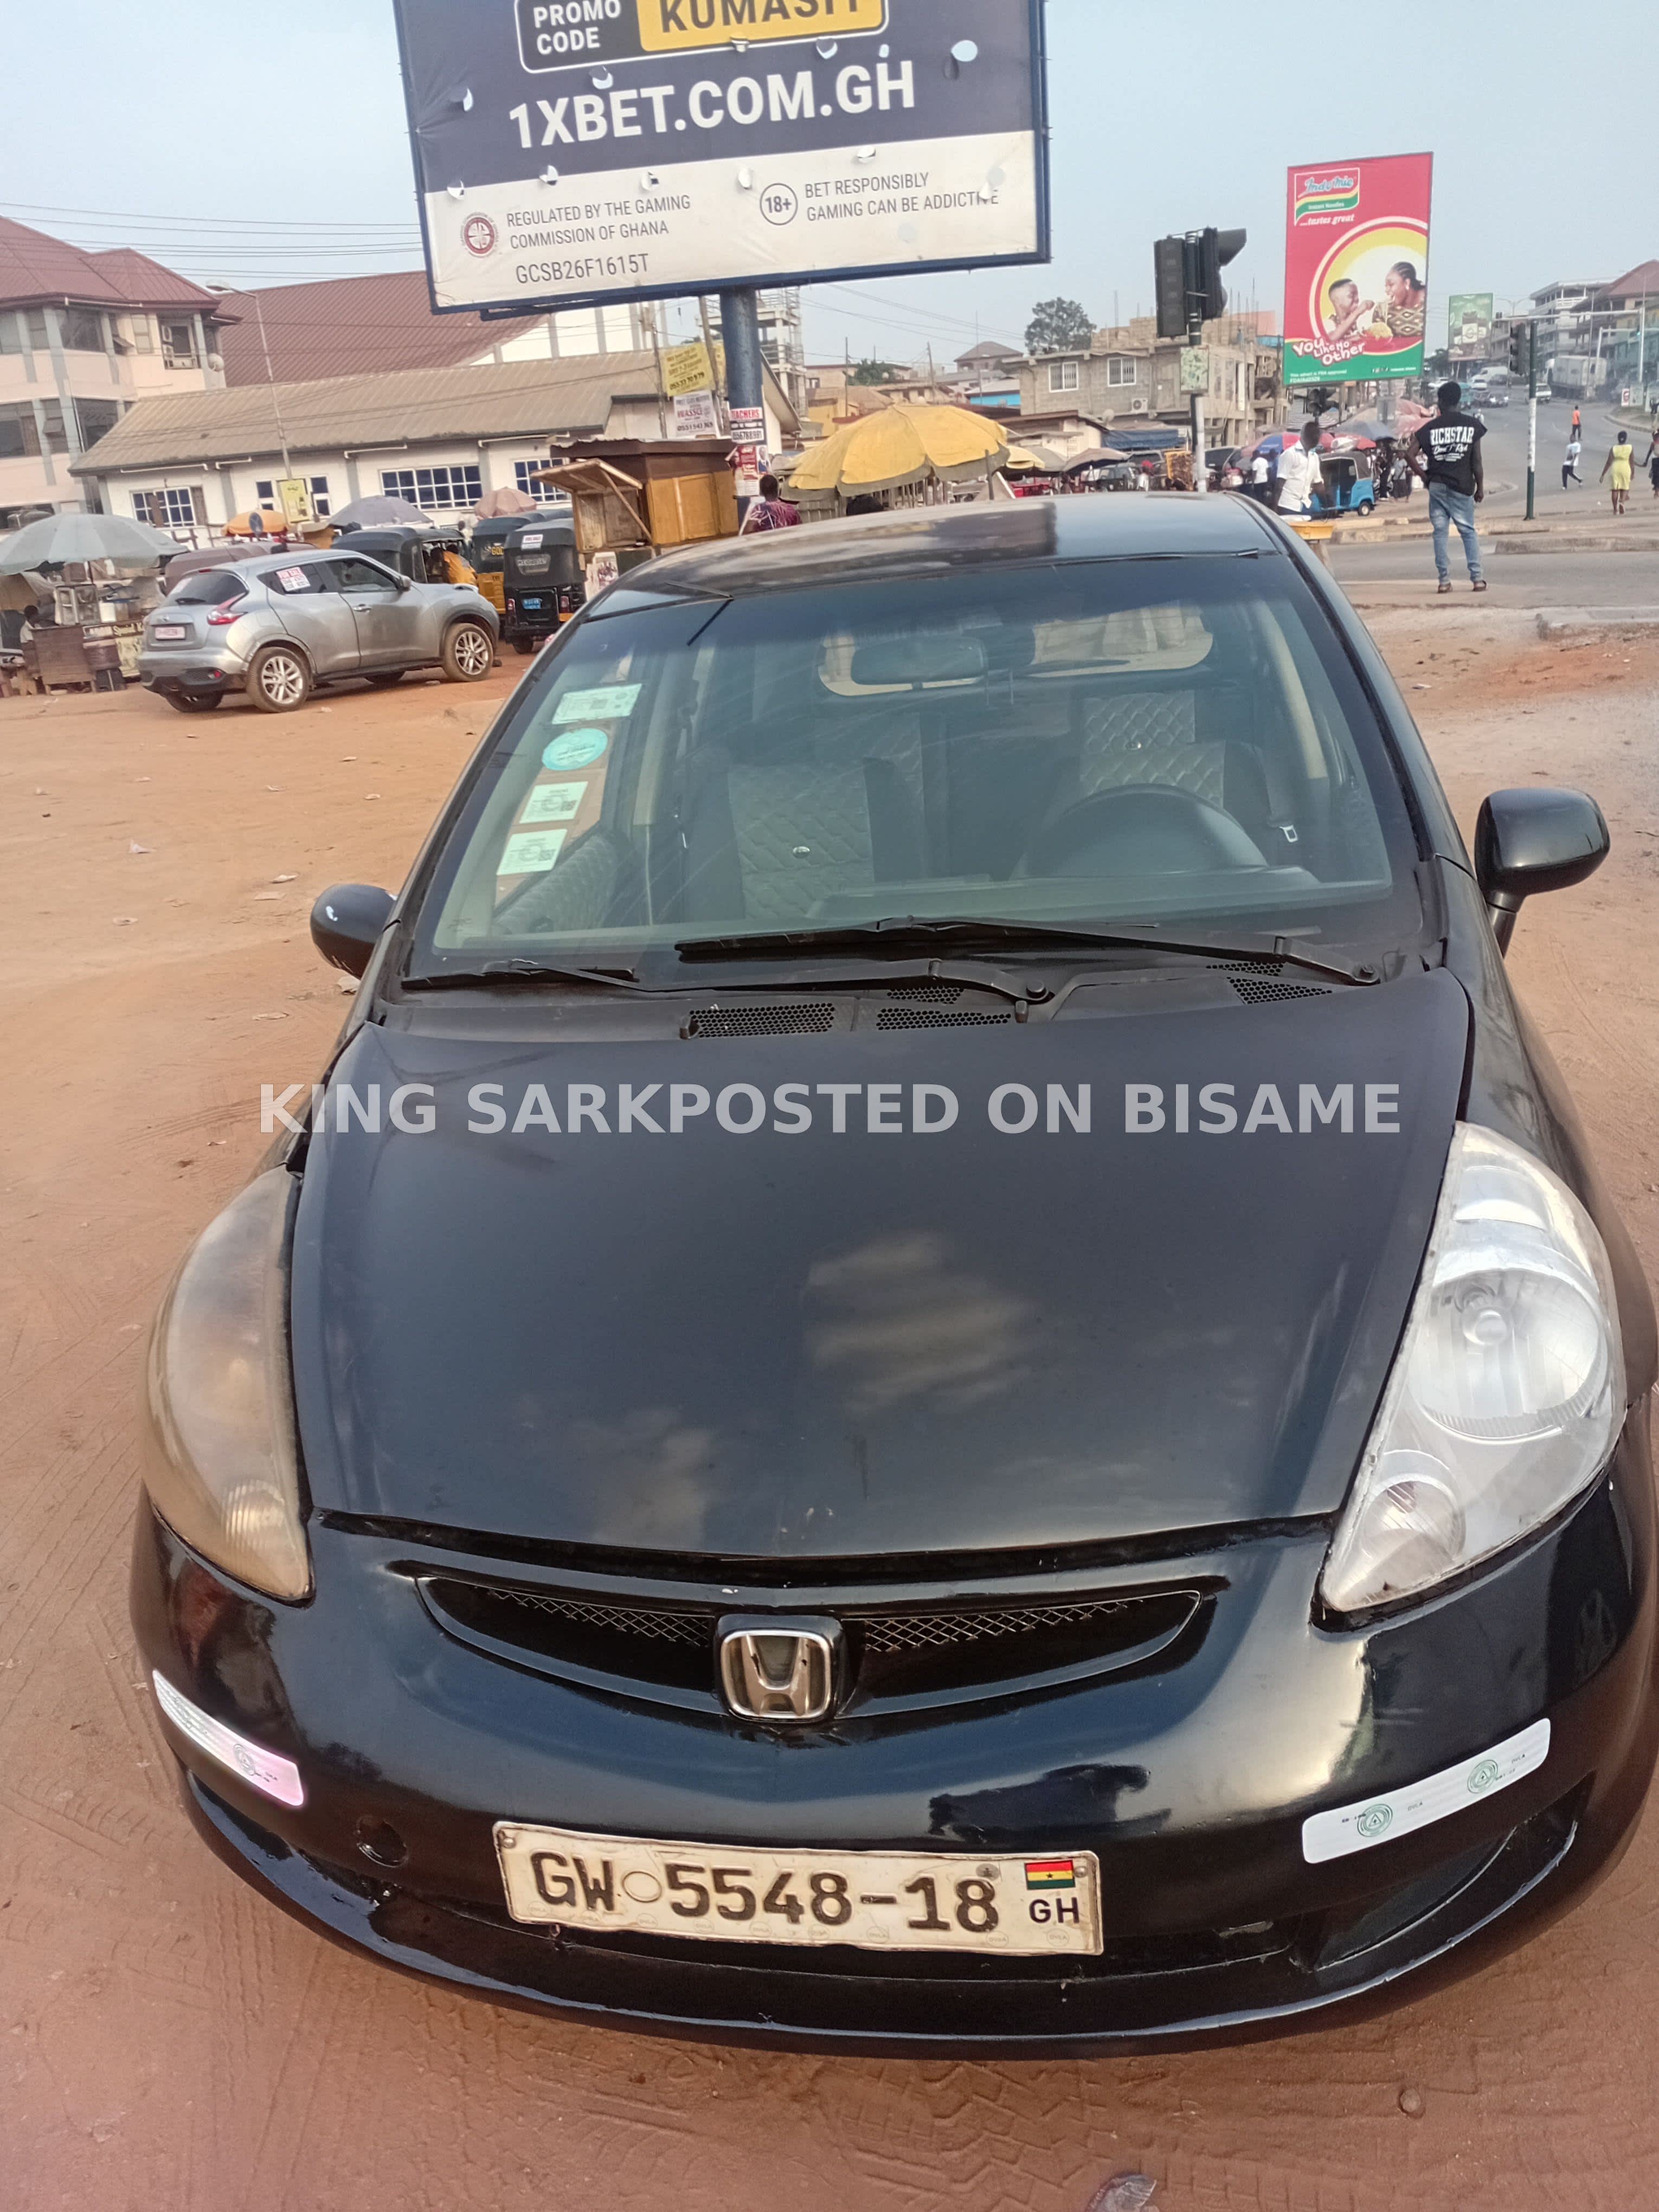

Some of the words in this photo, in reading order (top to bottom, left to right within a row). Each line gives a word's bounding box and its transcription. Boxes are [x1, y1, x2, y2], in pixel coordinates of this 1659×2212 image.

[533, 0, 621, 28] PROMO
[537, 27, 600, 55] CODE
[509, 60, 915, 148] 1XBET.COM.GH
[805, 181, 831, 198] BET
[835, 172, 929, 195] RESPONSIBLY
[506, 206, 582, 228] REGULATED
[585, 204, 601, 219] BY
[605, 201, 631, 216] THE
[635, 195, 691, 214] GAMING
[765, 196, 792, 213] 18+
[806, 202, 863, 221] GAMING
[867, 198, 897, 216] CAN
[902, 196, 919, 212] BE
[924, 189, 999, 210] ADDICTIE
[1332, 214, 1355, 225] great
[510, 228, 596, 249] COMMISSION
[599, 225, 615, 240] OF
[620, 221, 669, 239] GHANA
[516, 254, 649, 284] GCSB26F1615T
[1293, 338, 1324, 356] You
[1322, 343, 1365, 365] Other
[1430, 426, 1474, 445] RICHSTAR
[531, 1850, 615, 1912] GW
[664, 1863, 1000, 1933] 5548-18
[1030, 1897, 1079, 1924] GH
